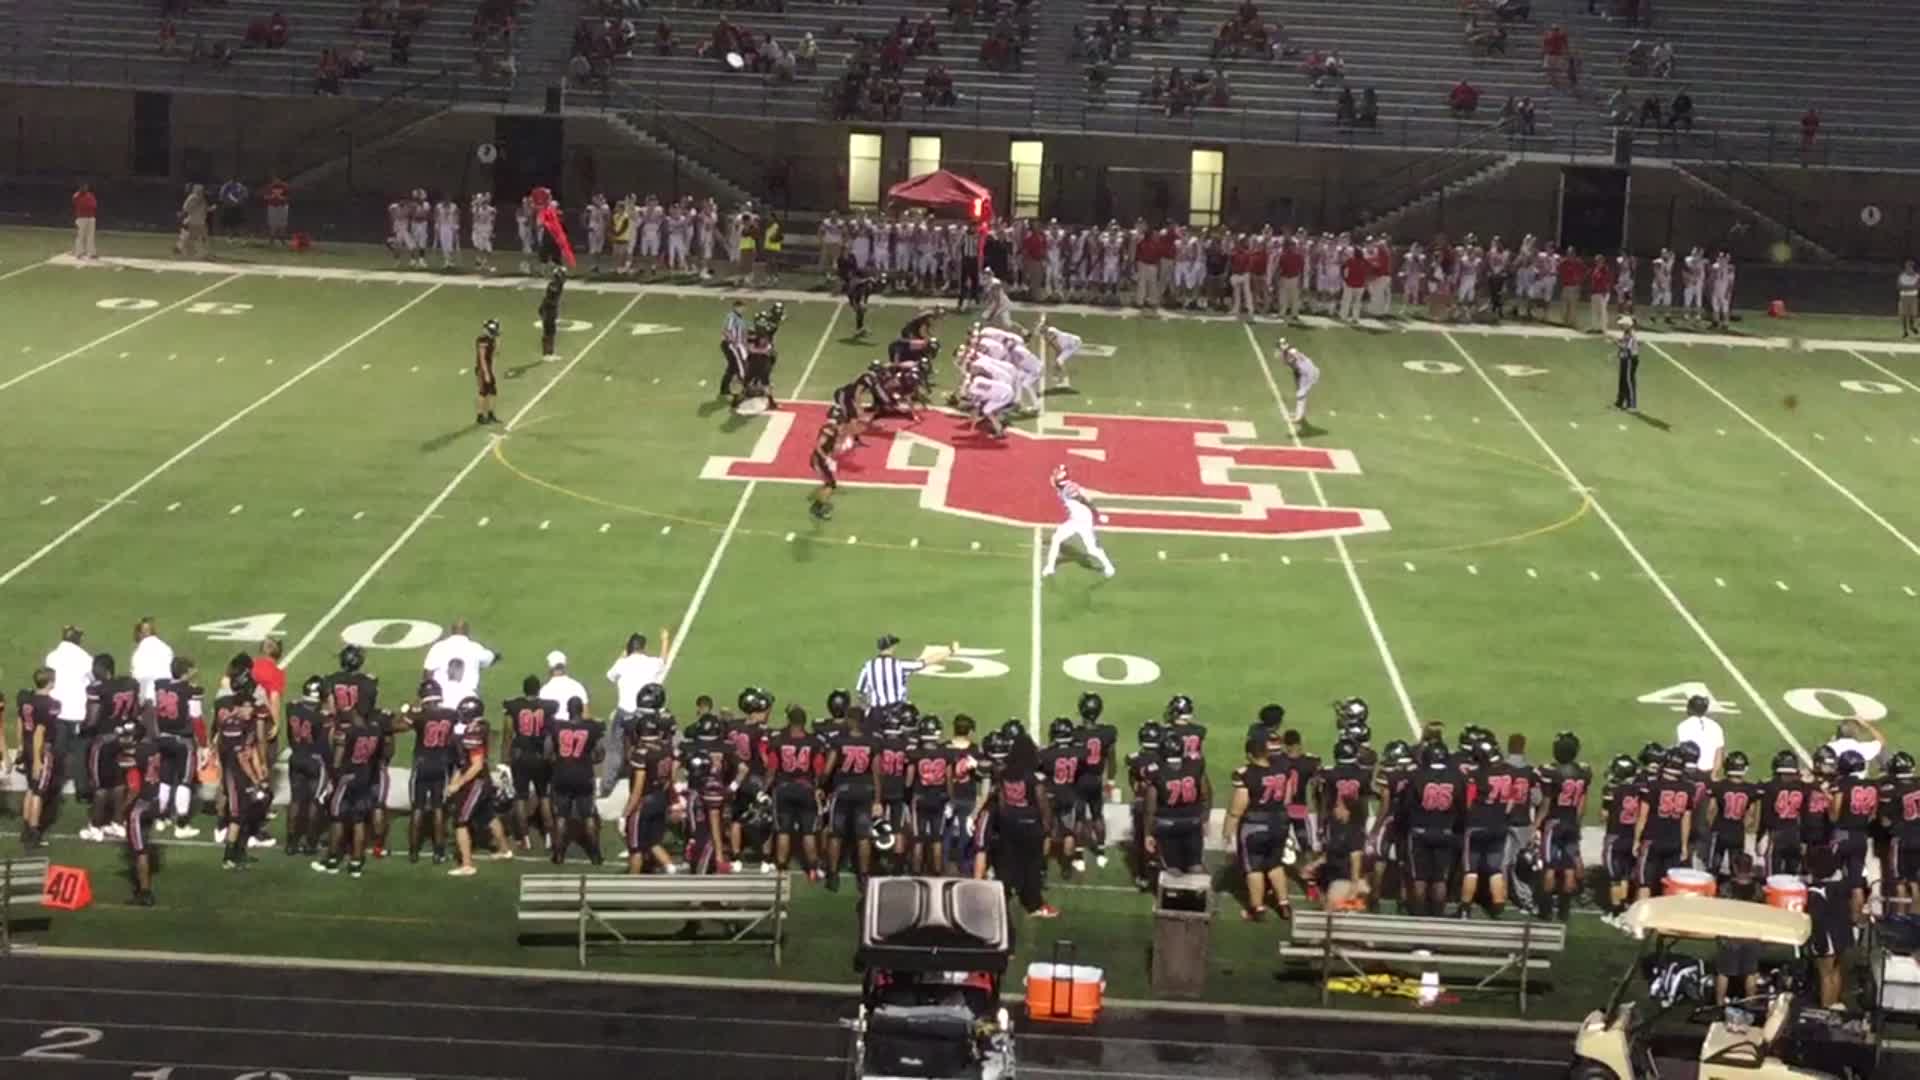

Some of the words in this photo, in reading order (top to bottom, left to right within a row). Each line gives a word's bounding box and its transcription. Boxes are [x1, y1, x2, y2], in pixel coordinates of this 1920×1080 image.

[188, 613, 443, 648] 40
[1636, 682, 1888, 720] 40
[47, 871, 79, 905] 40
[20, 1026, 104, 1060] 2
